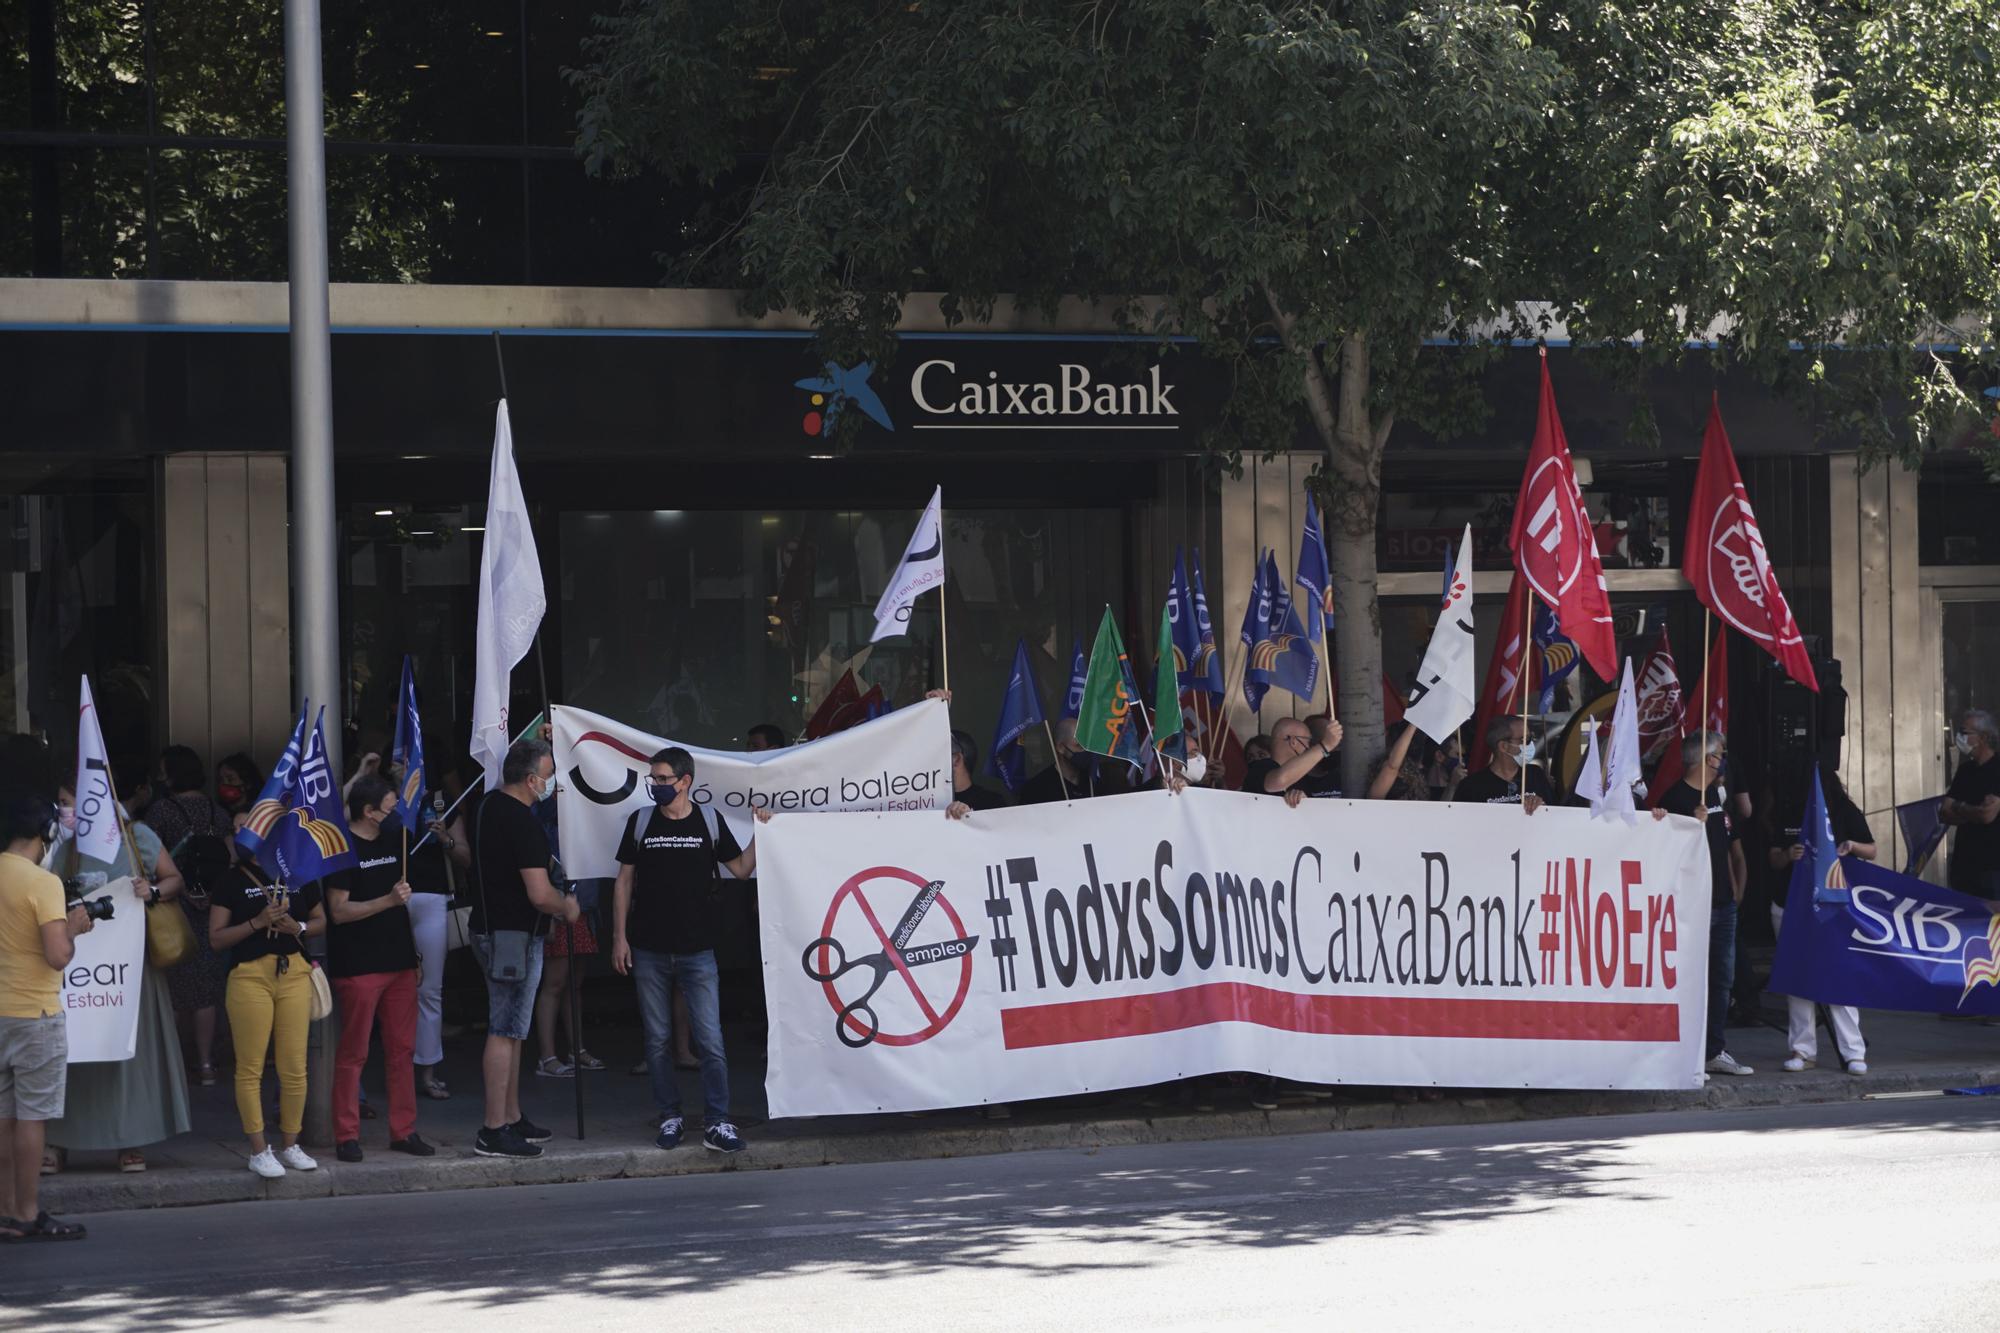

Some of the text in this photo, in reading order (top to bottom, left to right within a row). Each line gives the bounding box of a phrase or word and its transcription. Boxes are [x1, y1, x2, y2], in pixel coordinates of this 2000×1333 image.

[911, 359, 1180, 415] CaixaBank
[301, 728, 331, 804] SIB
[724, 786, 829, 810] obrera
[841, 769, 941, 803] balear
[895, 882, 942, 950] condiciones laborales
[1851, 885, 1964, 953] SIB
[906, 942, 967, 963] empleo
[67, 991, 123, 1009] Estalvi
